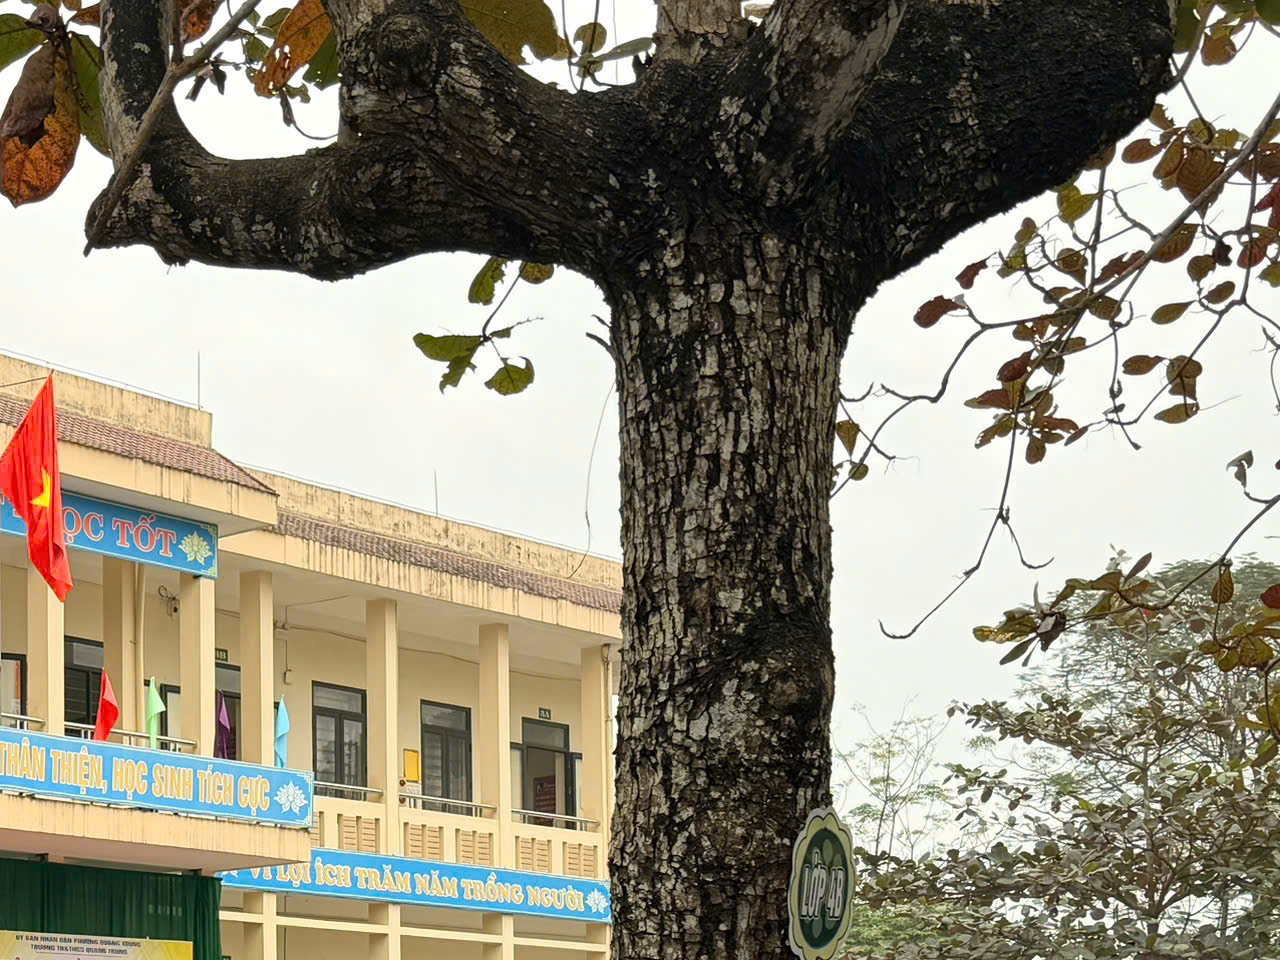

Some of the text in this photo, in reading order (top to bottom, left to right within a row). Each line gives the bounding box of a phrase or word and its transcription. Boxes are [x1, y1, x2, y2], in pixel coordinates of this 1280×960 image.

[61, 506, 105, 544] ỌC
[112, 511, 177, 558] TỐT
[50, 744, 108, 795] THIỆN,
[112, 756, 149, 801] HỌC
[152, 761, 194, 802] SINH
[197, 763, 234, 807] TÍCH
[237, 774, 272, 817] CỰC
[315, 857, 352, 888] ÍCH
[354, 864, 411, 894] TRĂM
[415, 869, 459, 899] NĂM
[461, 872, 523, 905] TRỒNG
[527, 885, 585, 912] NGƯỜI
[826, 868, 844, 918] 4B
